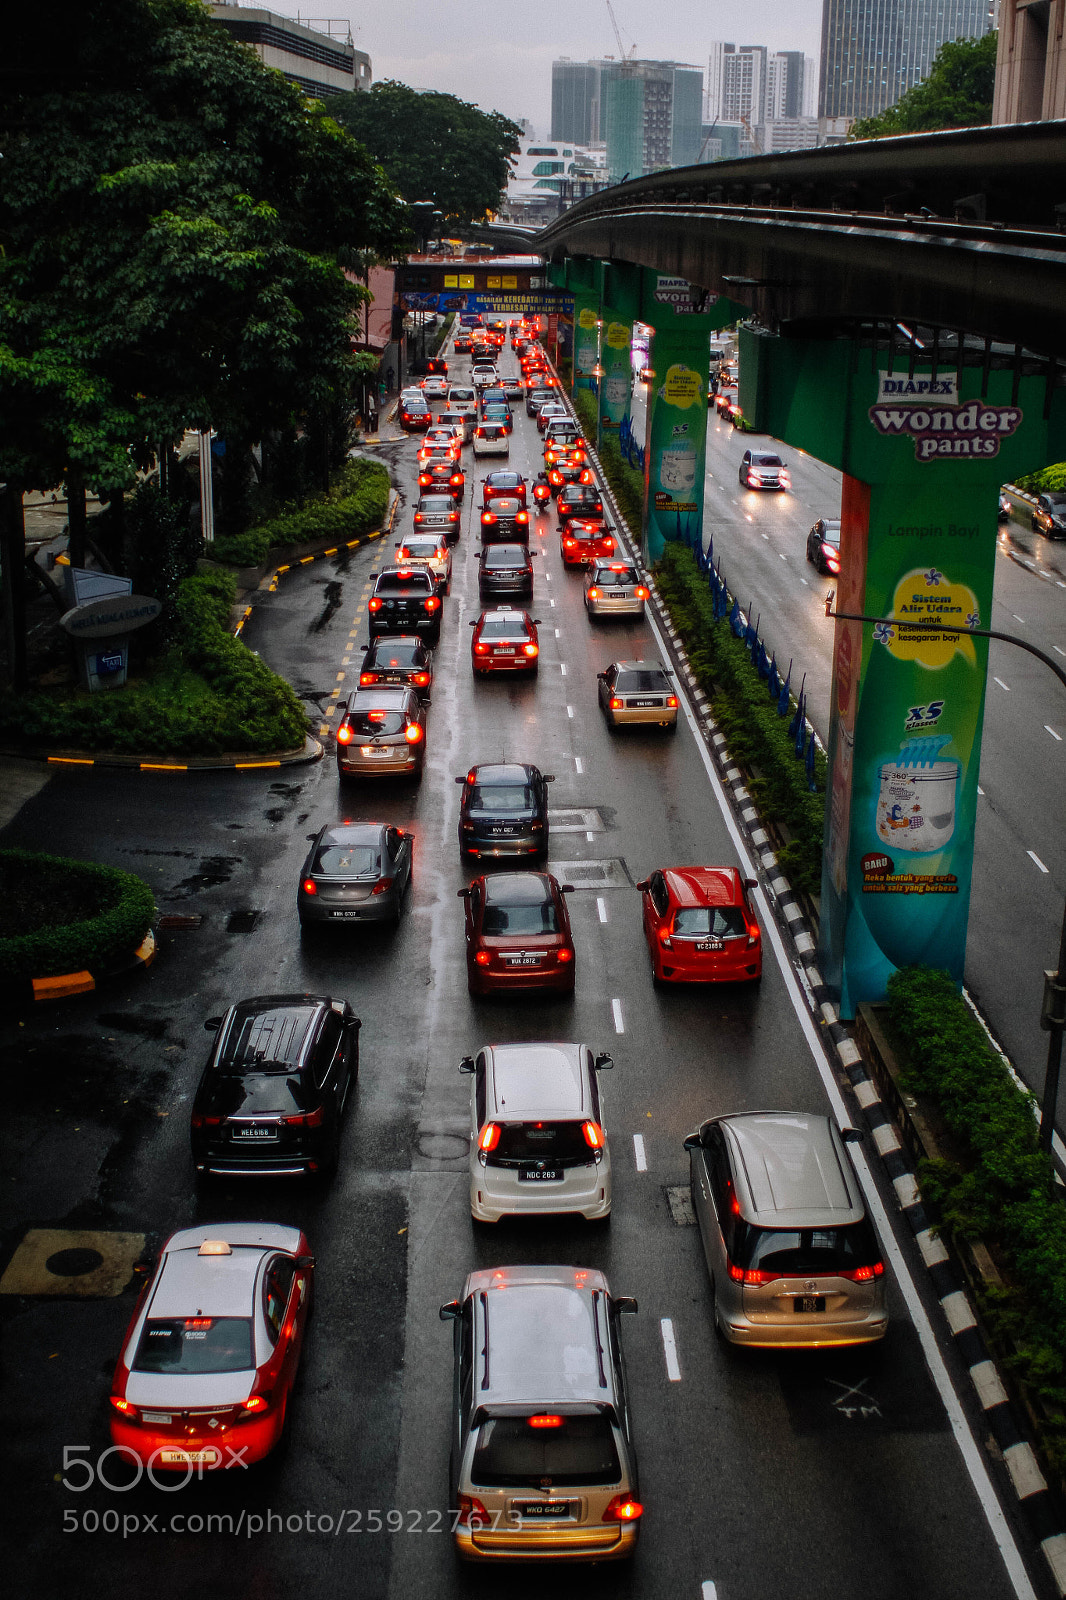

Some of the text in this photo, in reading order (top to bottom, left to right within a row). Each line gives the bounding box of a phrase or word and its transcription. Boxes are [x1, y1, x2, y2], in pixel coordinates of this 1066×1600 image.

[882, 380, 953, 394] DIAPEX
[874, 405, 1018, 431] wonder
[921, 437, 995, 457] pants
[888, 524, 980, 540] Lampin Bayi
[912, 594, 951, 603] Sistem
[898, 634, 960, 642] kesegaran bayi
[864, 858, 888, 870] BARU
